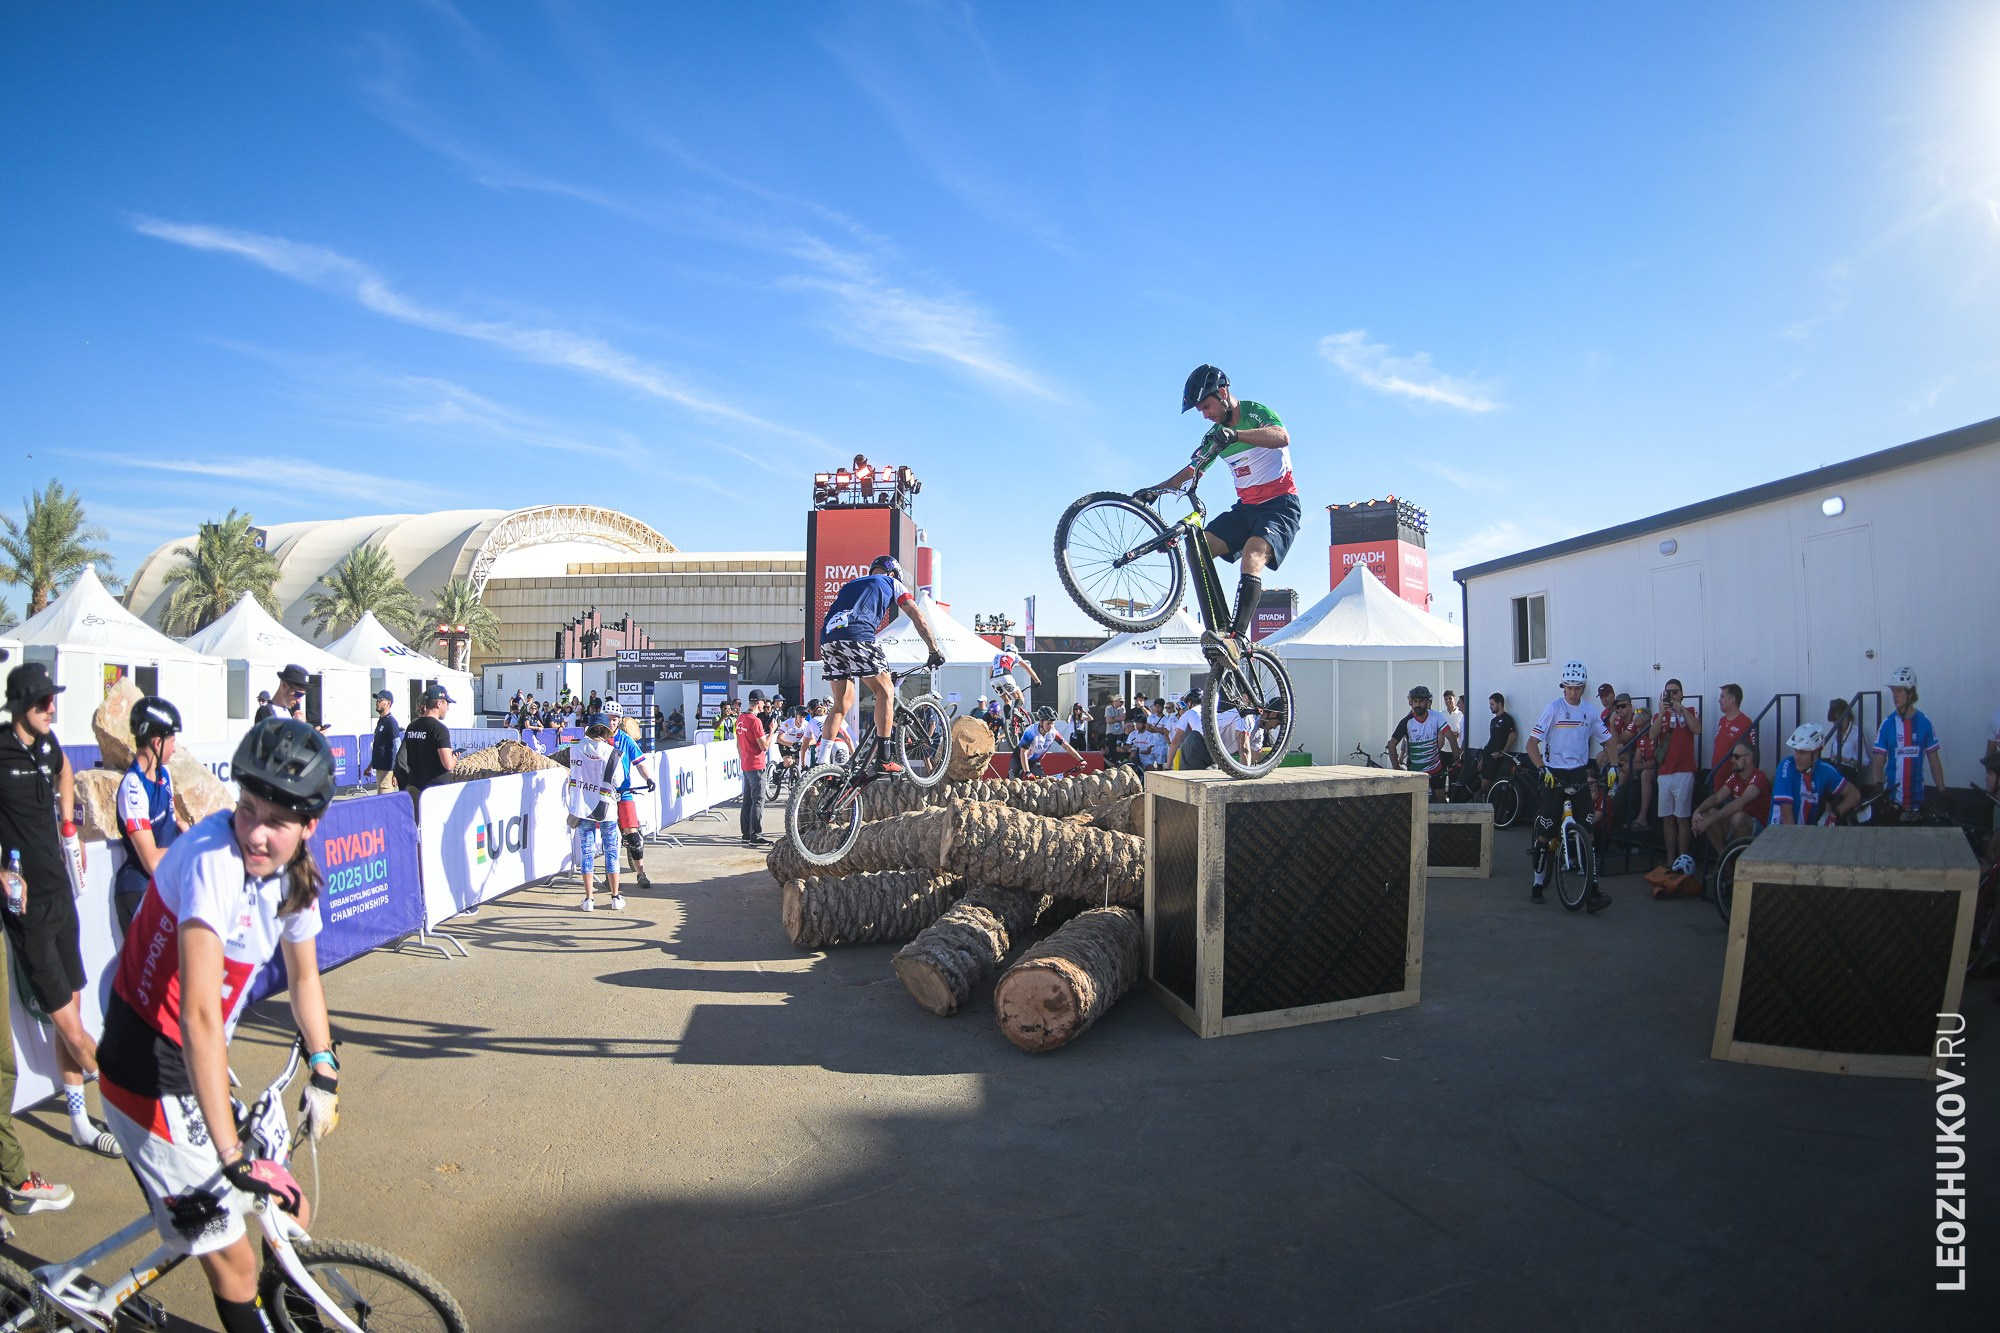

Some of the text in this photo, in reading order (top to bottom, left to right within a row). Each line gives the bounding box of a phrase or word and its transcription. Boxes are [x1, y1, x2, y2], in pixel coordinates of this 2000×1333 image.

[1343, 551, 1386, 565] RIYADH
[825, 565, 870, 579] RIYAD
[1258, 613, 1285, 621] RIYADH
[621, 652, 638, 660] UCI
[659, 671, 683, 679] START
[623, 684, 639, 692] UCI
[680, 770, 694, 797] UCI
[487, 813, 529, 860] UCI
[325, 827, 385, 868] RIYADH
[328, 858, 388, 895] 2025 UCI
[329, 882, 389, 909] URBAN CYCLING WORLD
[331, 894, 389, 923] CHAMPIONSHIPS
